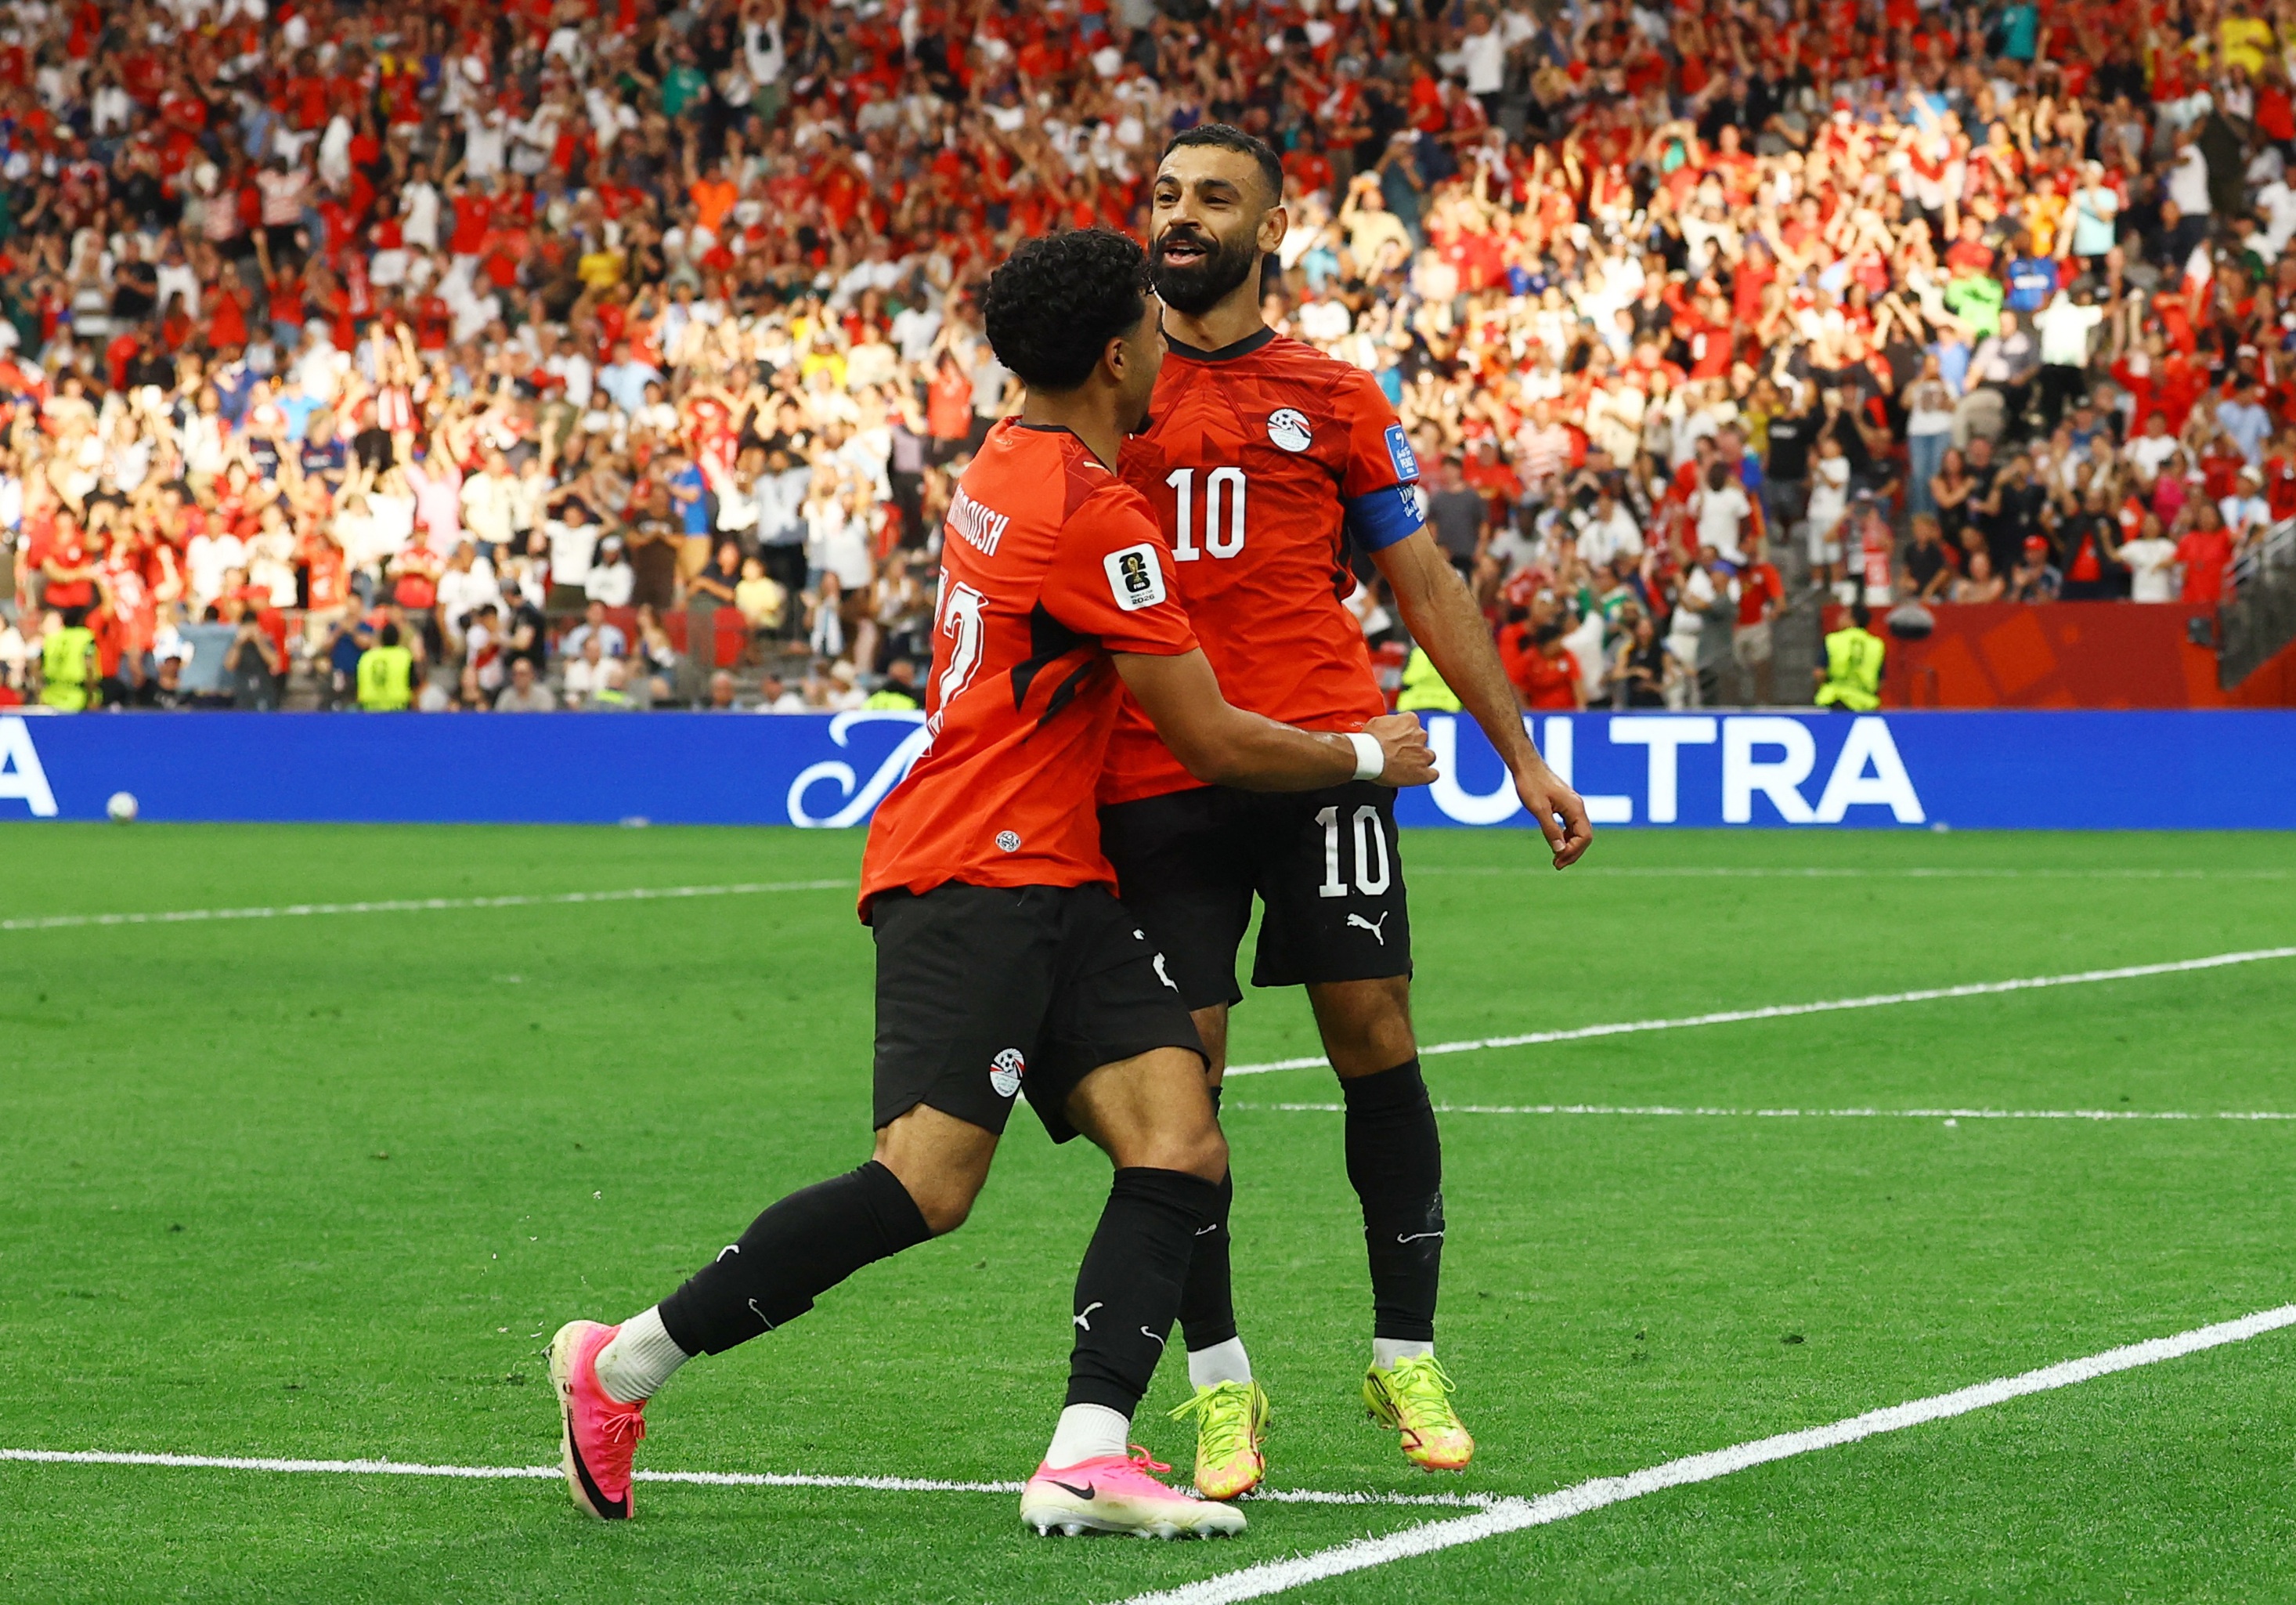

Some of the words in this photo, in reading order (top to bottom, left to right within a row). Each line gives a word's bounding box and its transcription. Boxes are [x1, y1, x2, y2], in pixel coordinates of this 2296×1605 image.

[1166, 467, 1246, 562] 10
[1132, 594, 1154, 604] 2026
[1428, 716, 1926, 824] ULTRA
[1315, 805, 1390, 897] 10
